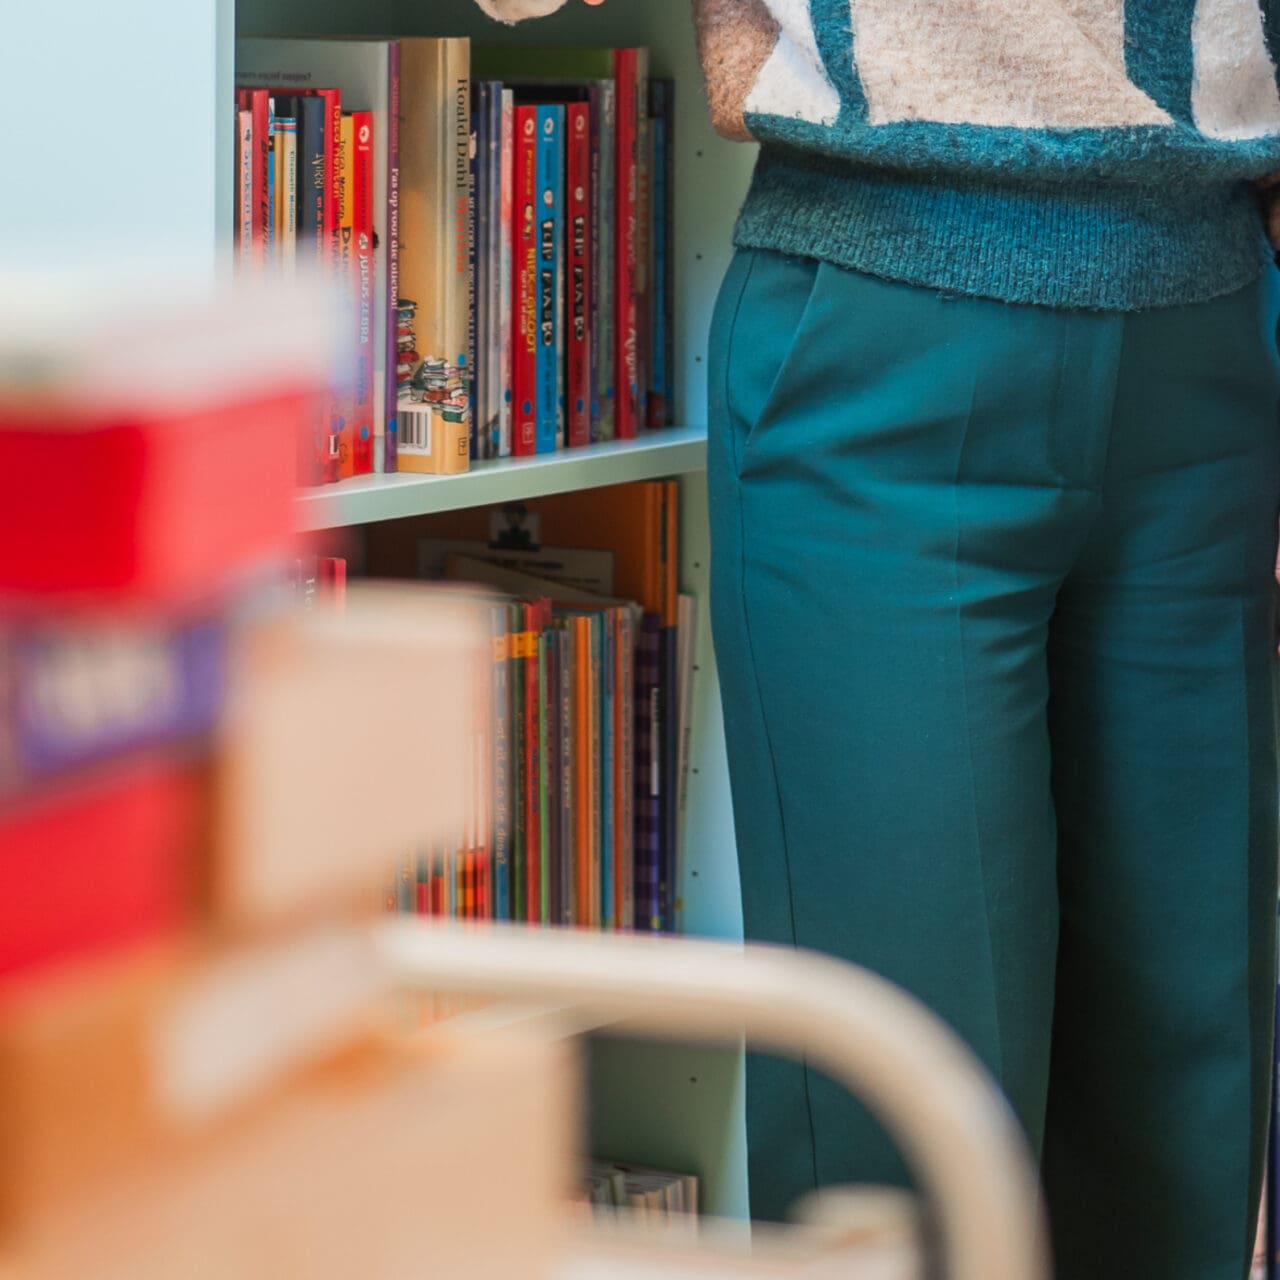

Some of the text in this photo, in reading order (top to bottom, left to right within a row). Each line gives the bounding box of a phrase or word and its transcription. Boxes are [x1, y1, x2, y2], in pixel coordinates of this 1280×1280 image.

[332, 104, 342, 199] Tosca Menten
[455, 78, 469, 273] Roald Dahl Matilda
[388, 191, 398, 207] op
[390, 210, 398, 238] voor
[390, 239, 399, 258] die
[358, 254, 370, 345] JULIUS ZEBRA
[526, 296, 537, 353] GROOT
